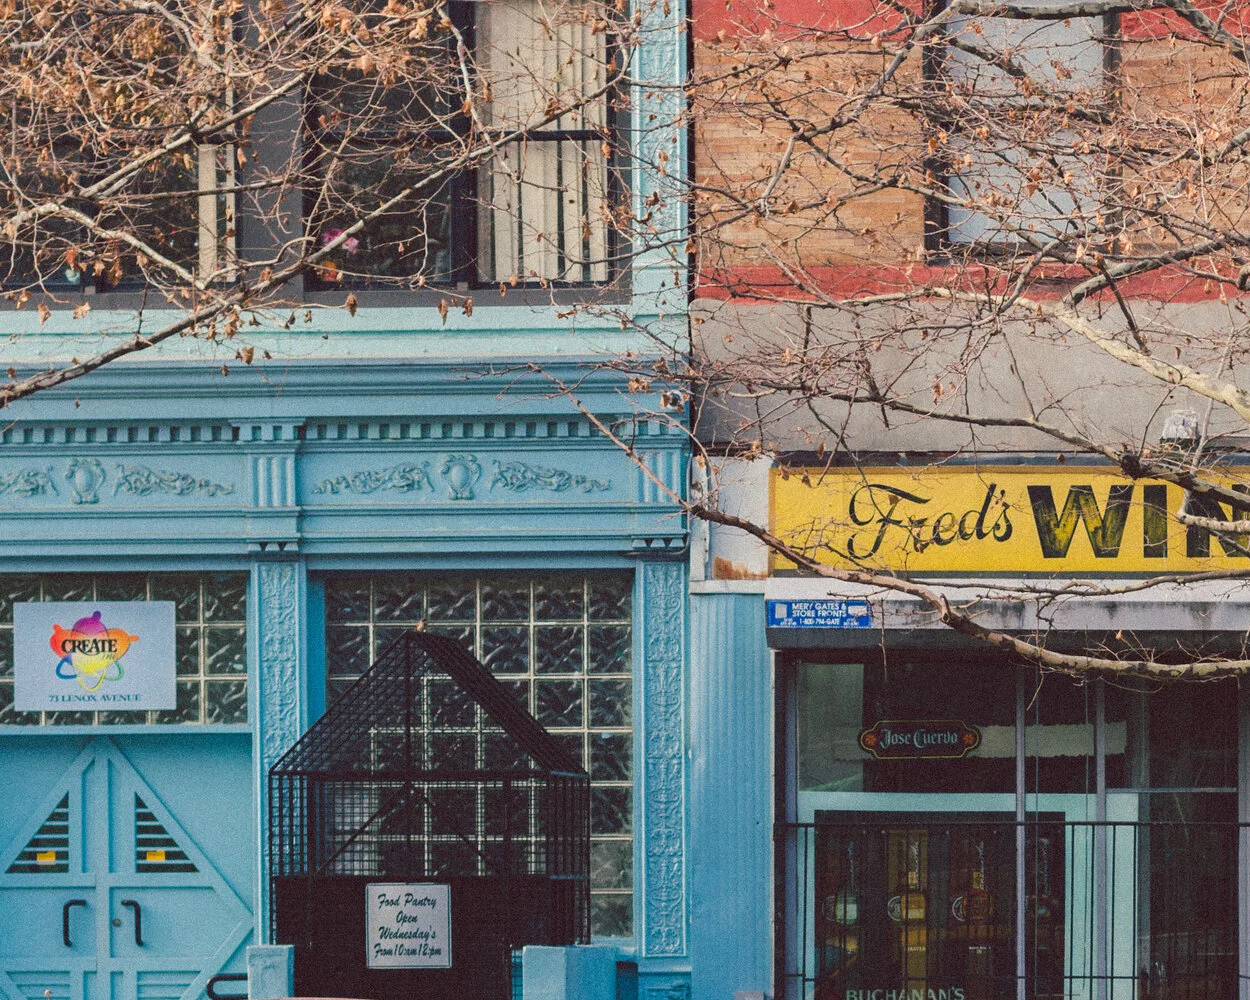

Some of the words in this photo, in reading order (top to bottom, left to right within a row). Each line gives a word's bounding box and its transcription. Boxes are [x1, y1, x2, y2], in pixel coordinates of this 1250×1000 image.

[847, 483, 1013, 560] Fred's
[791, 609, 816, 618] STORE
[817, 609, 847, 618] FRONTS
[814, 602, 839, 610] GATES
[61, 638, 118, 656] CREATE
[61, 694, 97, 703] LENOX
[100, 694, 140, 702] AVENUE
[880, 728, 911, 749] Jose
[913, 728, 958, 748] Cuervo
[377, 893, 401, 909] Food
[404, 892, 437, 909] Pantry
[396, 910, 418, 926] Open
[378, 925, 436, 942] Wednesday's
